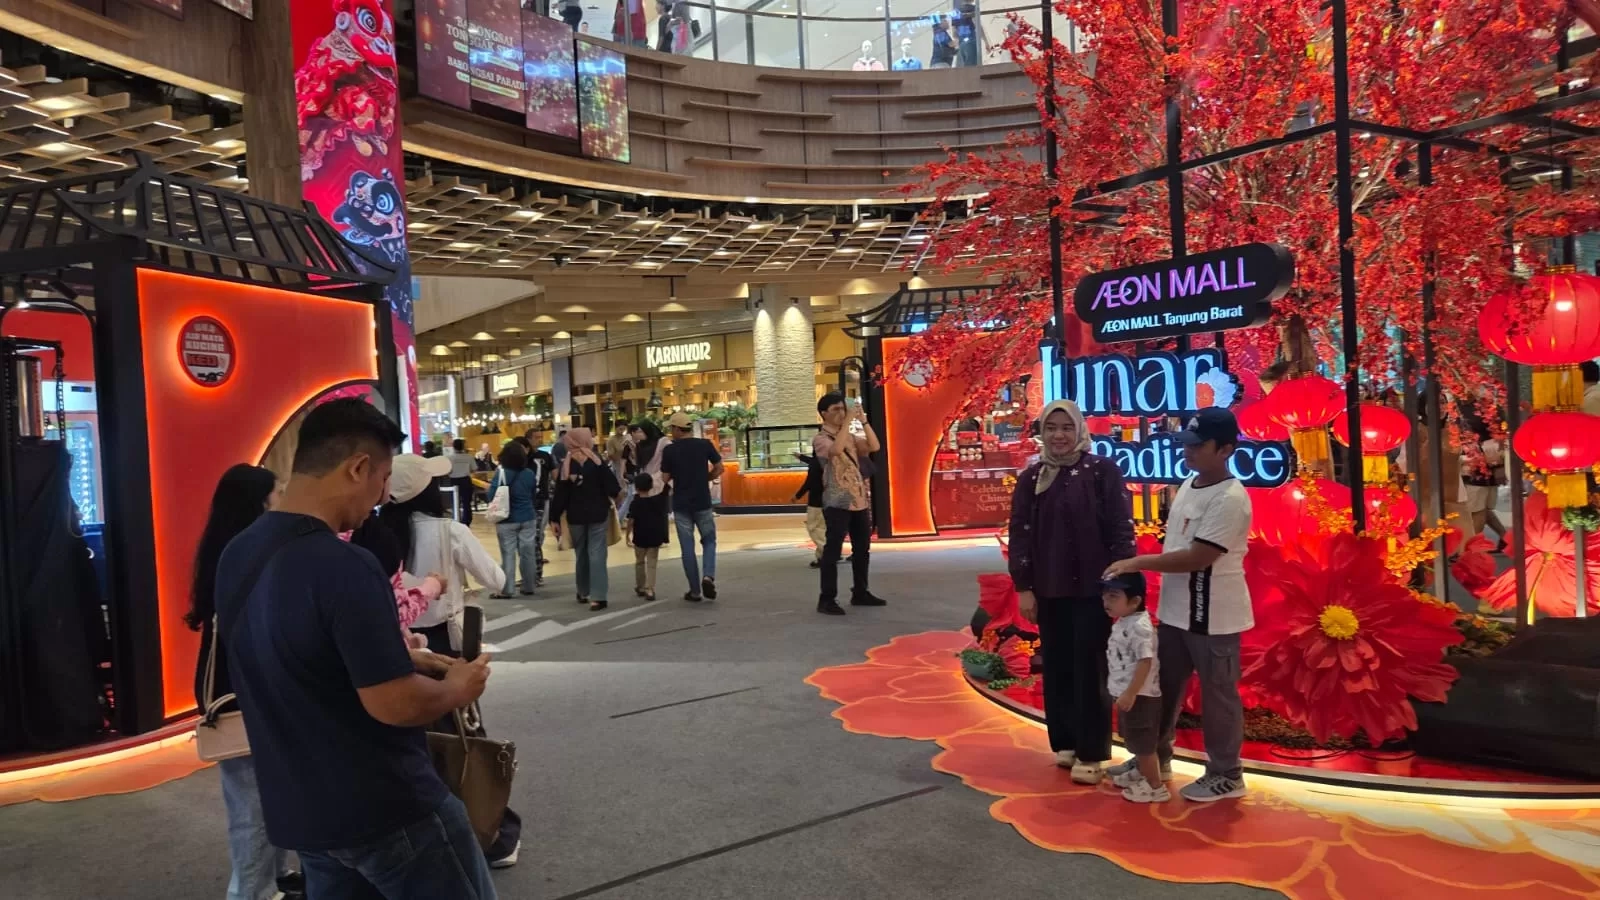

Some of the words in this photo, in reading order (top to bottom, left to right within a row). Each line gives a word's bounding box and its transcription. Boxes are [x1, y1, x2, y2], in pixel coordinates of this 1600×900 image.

[1169, 257, 1256, 299] MALL
[1131, 315, 1162, 330] MALL
[1163, 309, 1208, 327] Tanjung
[1210, 304, 1244, 320] Barat
[645, 341, 712, 369] KARNIVOR
[1090, 438, 1285, 481] adiace
[970, 484, 1006, 494] Celebra
[980, 493, 1012, 503] Chines
[976, 502, 997, 512] New
[1195, 593, 1204, 622] NEVER
